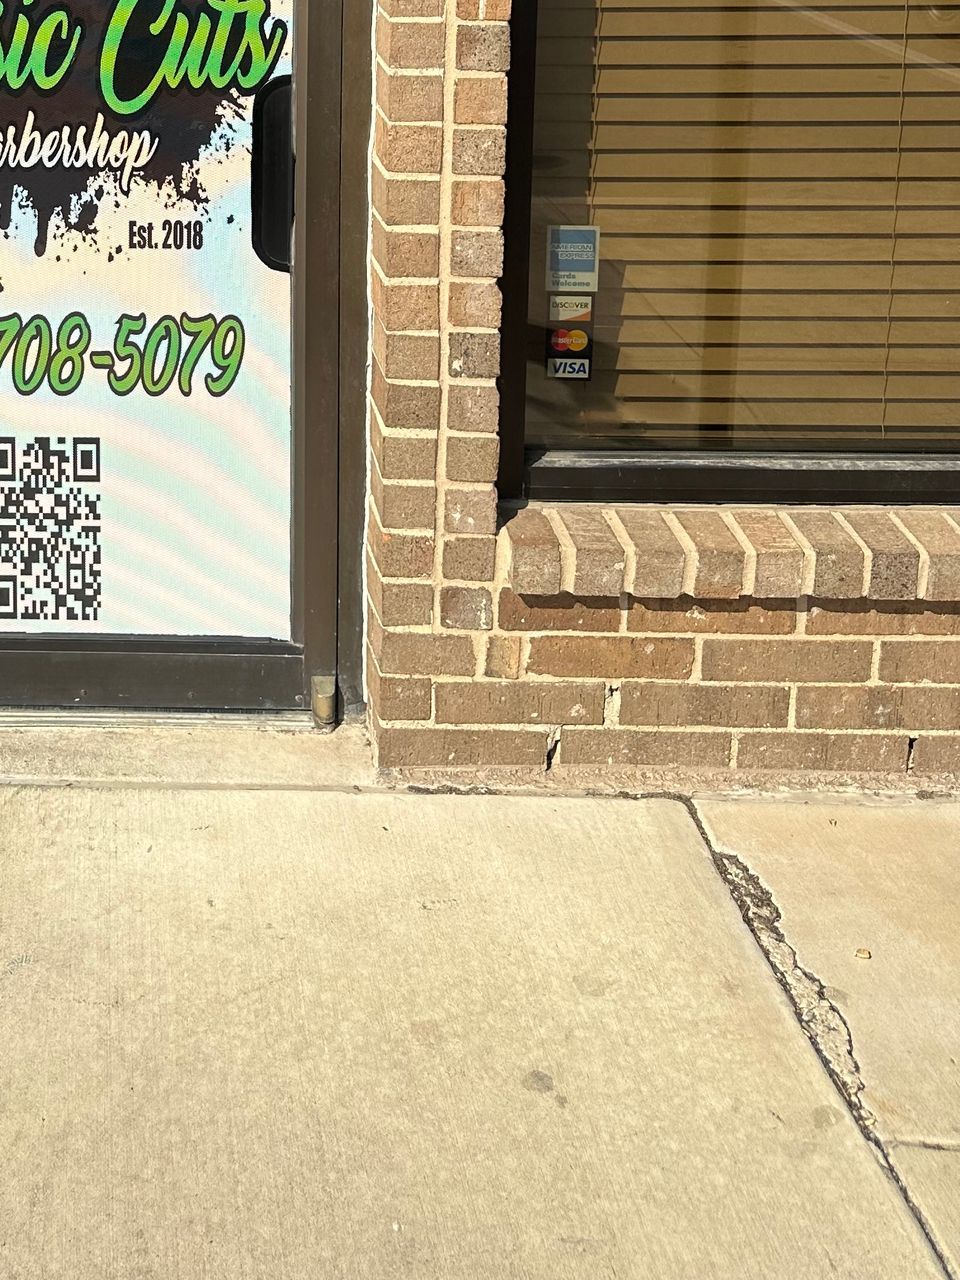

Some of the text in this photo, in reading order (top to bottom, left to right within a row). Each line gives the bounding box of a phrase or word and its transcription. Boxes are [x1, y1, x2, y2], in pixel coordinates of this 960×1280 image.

[128, 219, 204, 250] Est. 2018
[551, 243, 593, 251] AMERICAN
[559, 252, 595, 260] EXPRESS
[551, 301, 590, 309] DISCOVER
[553, 361, 588, 375] VISA
